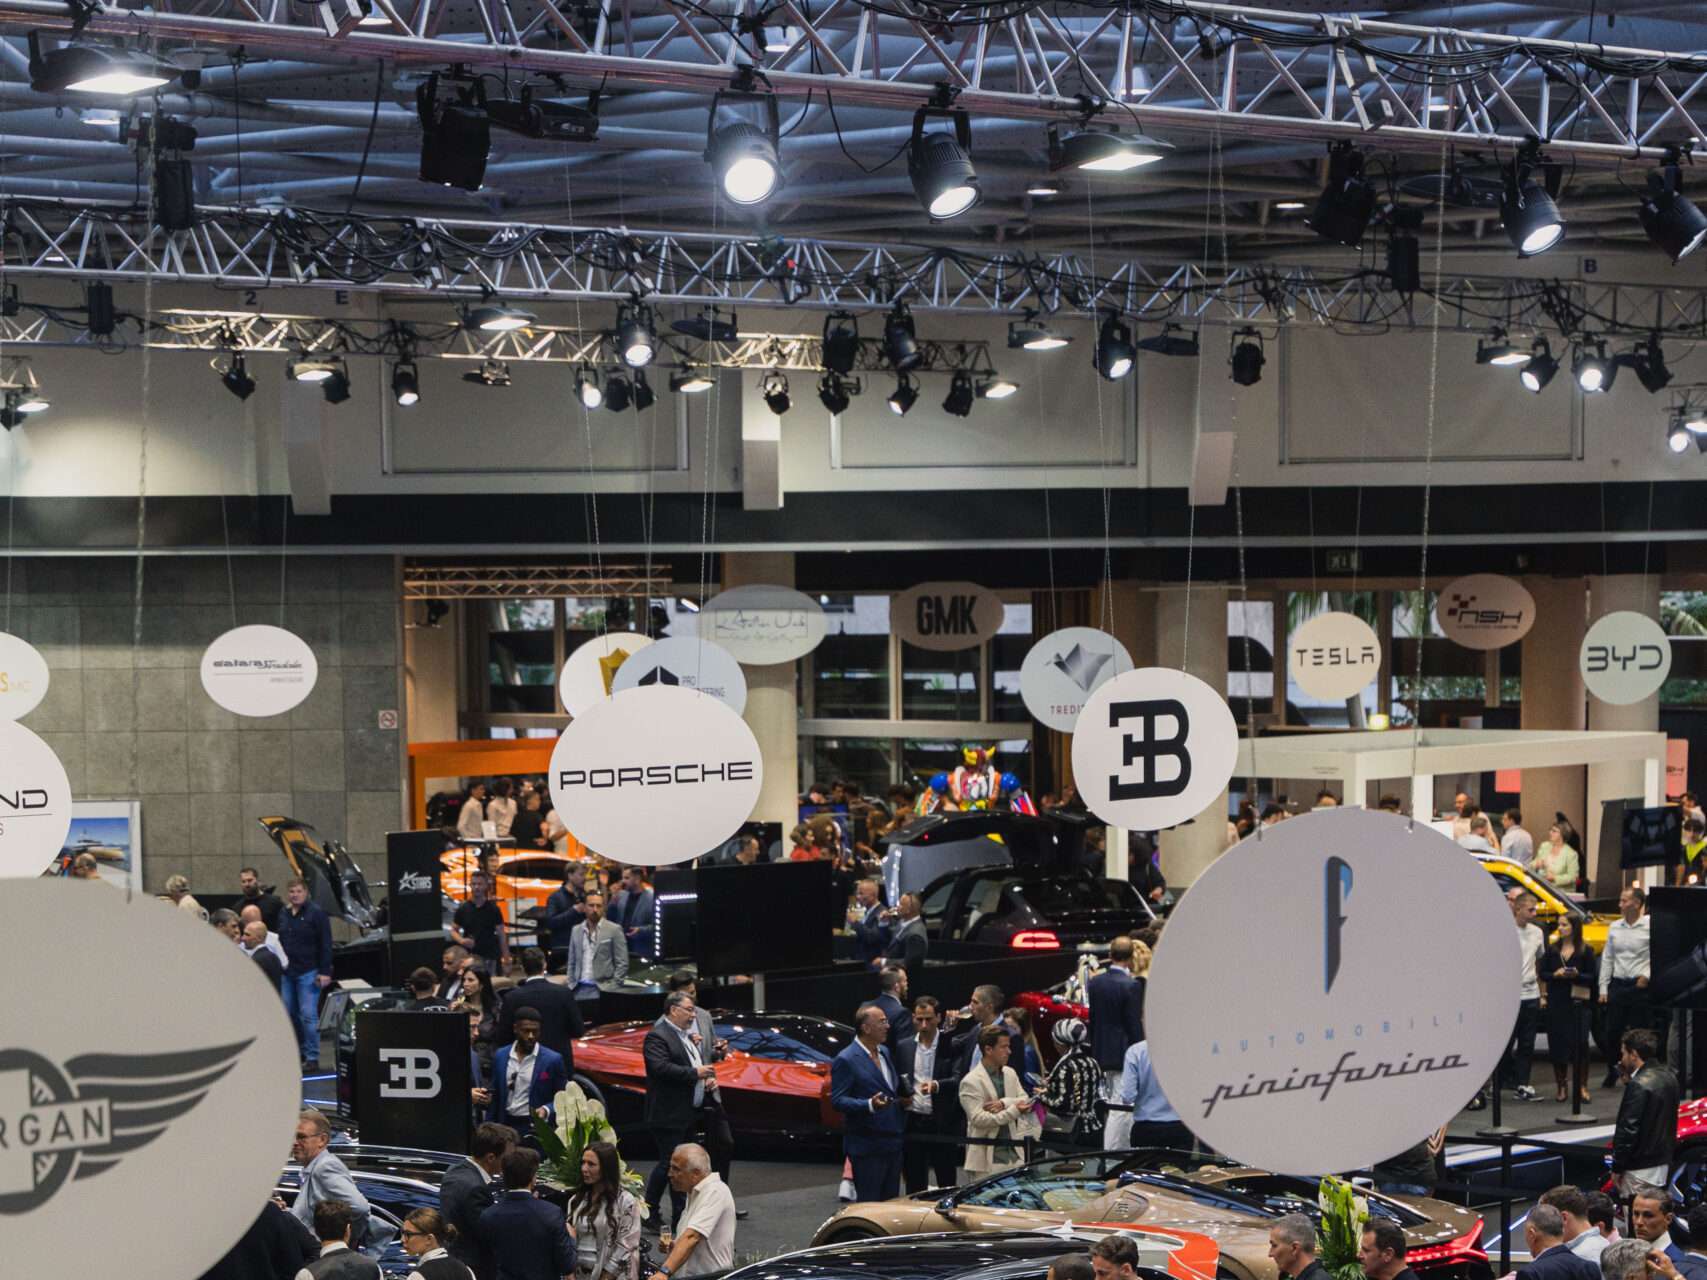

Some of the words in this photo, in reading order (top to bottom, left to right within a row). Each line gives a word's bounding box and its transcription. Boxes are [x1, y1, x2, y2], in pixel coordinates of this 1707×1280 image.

[245, 290, 257, 305] 2
[335, 290, 349, 305] E
[917, 595, 978, 635] GMK
[1296, 646, 1375, 667] TESLA
[1587, 645, 1663, 672] BYD
[560, 761, 753, 790] PORSCHE
[1211, 1011, 1464, 1055] AUTOMOBILI
[1201, 1050, 1470, 1119] pininfarina
